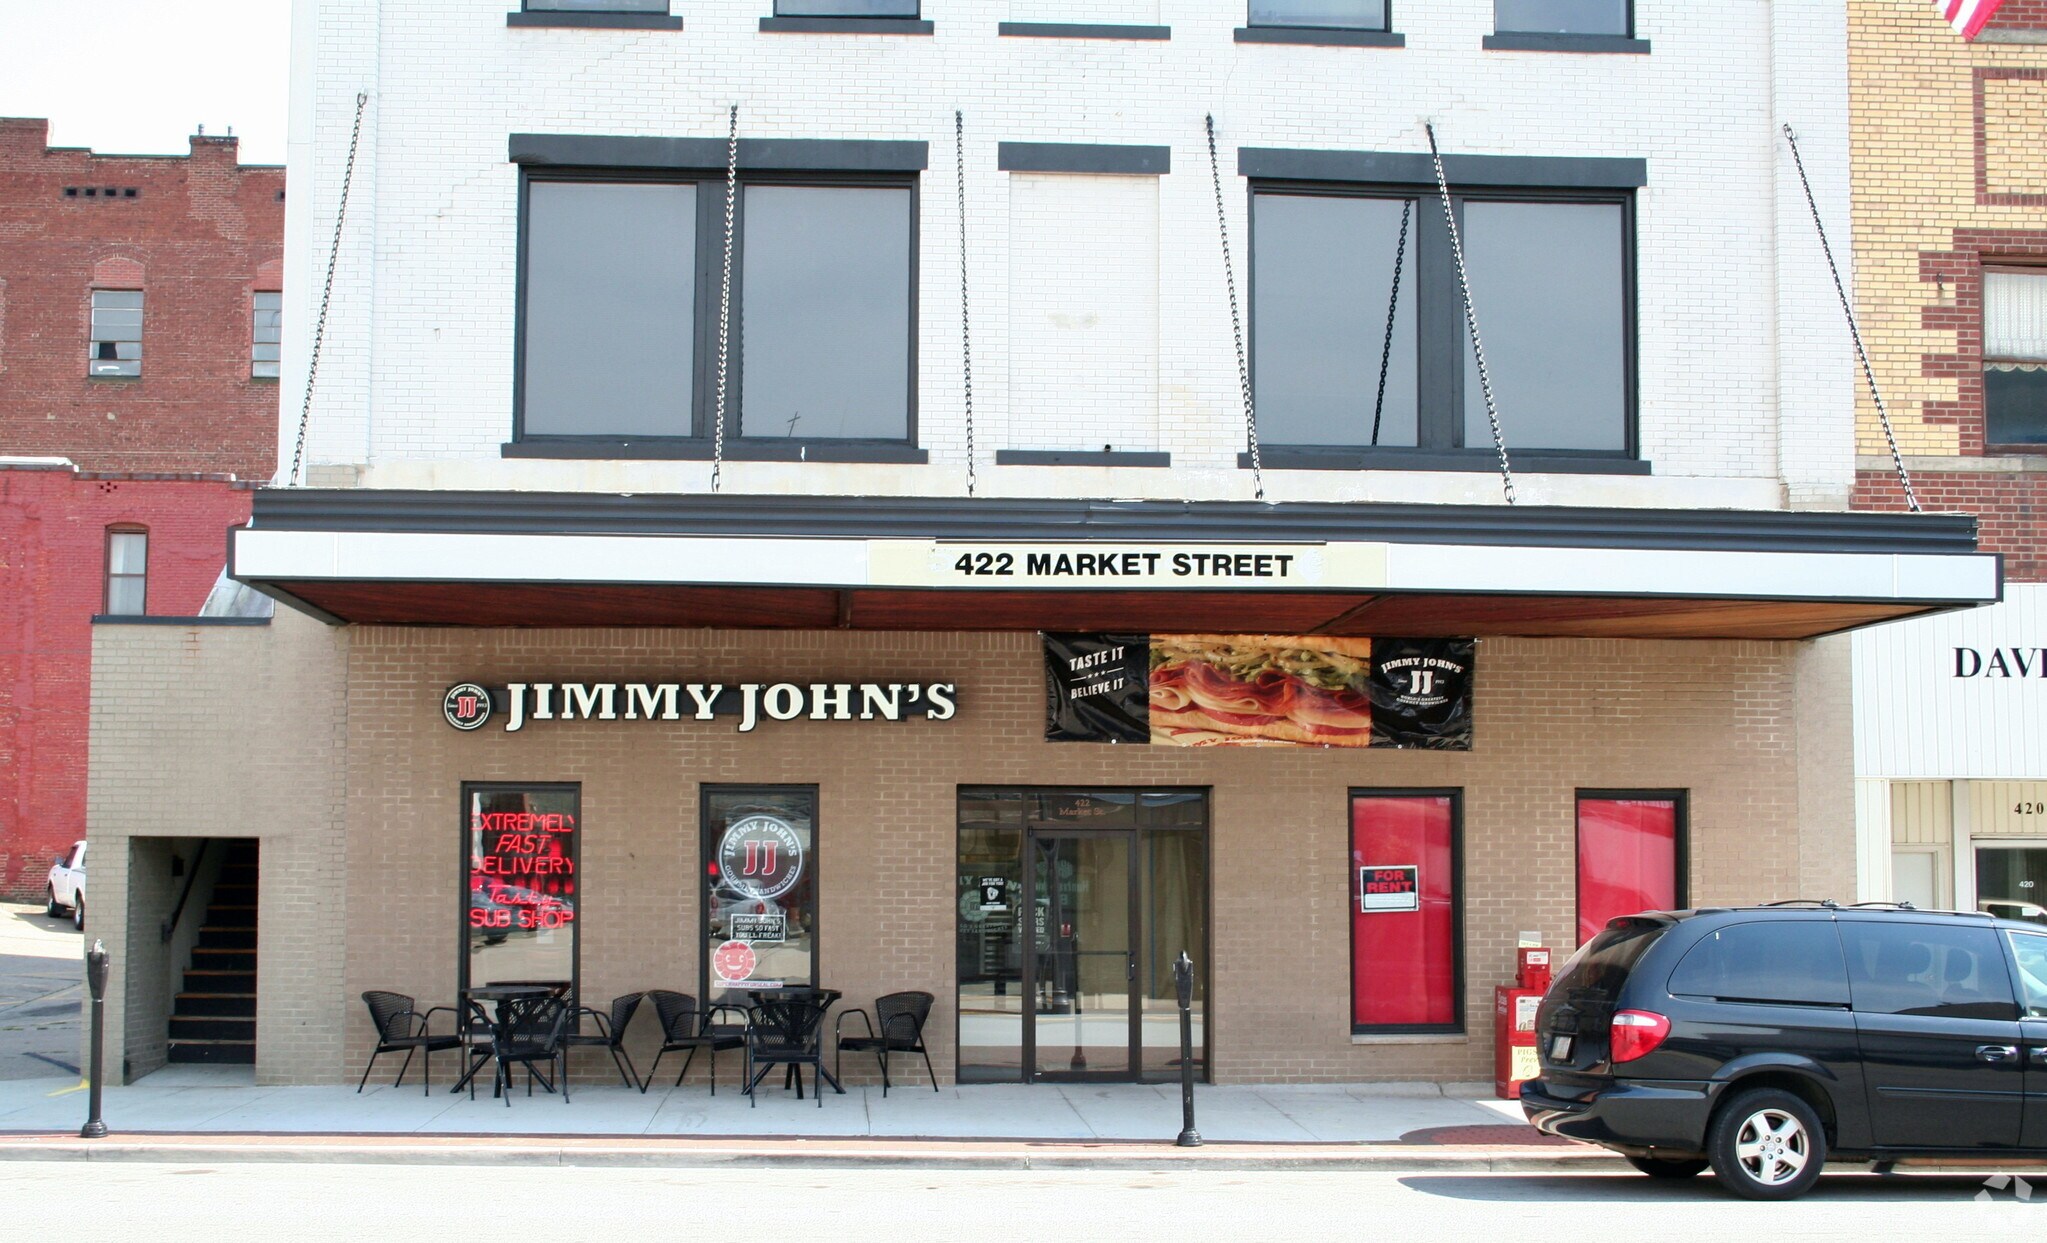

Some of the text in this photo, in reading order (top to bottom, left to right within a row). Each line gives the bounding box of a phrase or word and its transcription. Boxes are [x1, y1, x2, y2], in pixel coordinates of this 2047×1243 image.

[955, 553, 1294, 577] 422 MARKET STREET
[1069, 646, 1124, 671] TASTE IT
[1381, 657, 1462, 674] JIMMY JOHN'S
[1071, 677, 1124, 700] BELIEVE IT
[1410, 670, 1433, 694] JJ
[457, 696, 477, 718] JJ
[505, 683, 956, 731] JIMMY JOHN'S
[1059, 807, 1091, 816] Market
[1074, 799, 1090, 807] 422
[2014, 802, 2044, 815] 420
[495, 834, 552, 854] FAST
[723, 821, 797, 857] JIMMY JOHN'S
[742, 840, 779, 876] JJ
[1374, 870, 1405, 881] FOR
[2019, 880, 2034, 888] 420
[487, 884, 562, 909] Tasty
[1366, 881, 1412, 893] RENT
[470, 908, 574, 928] SUB SHOP
